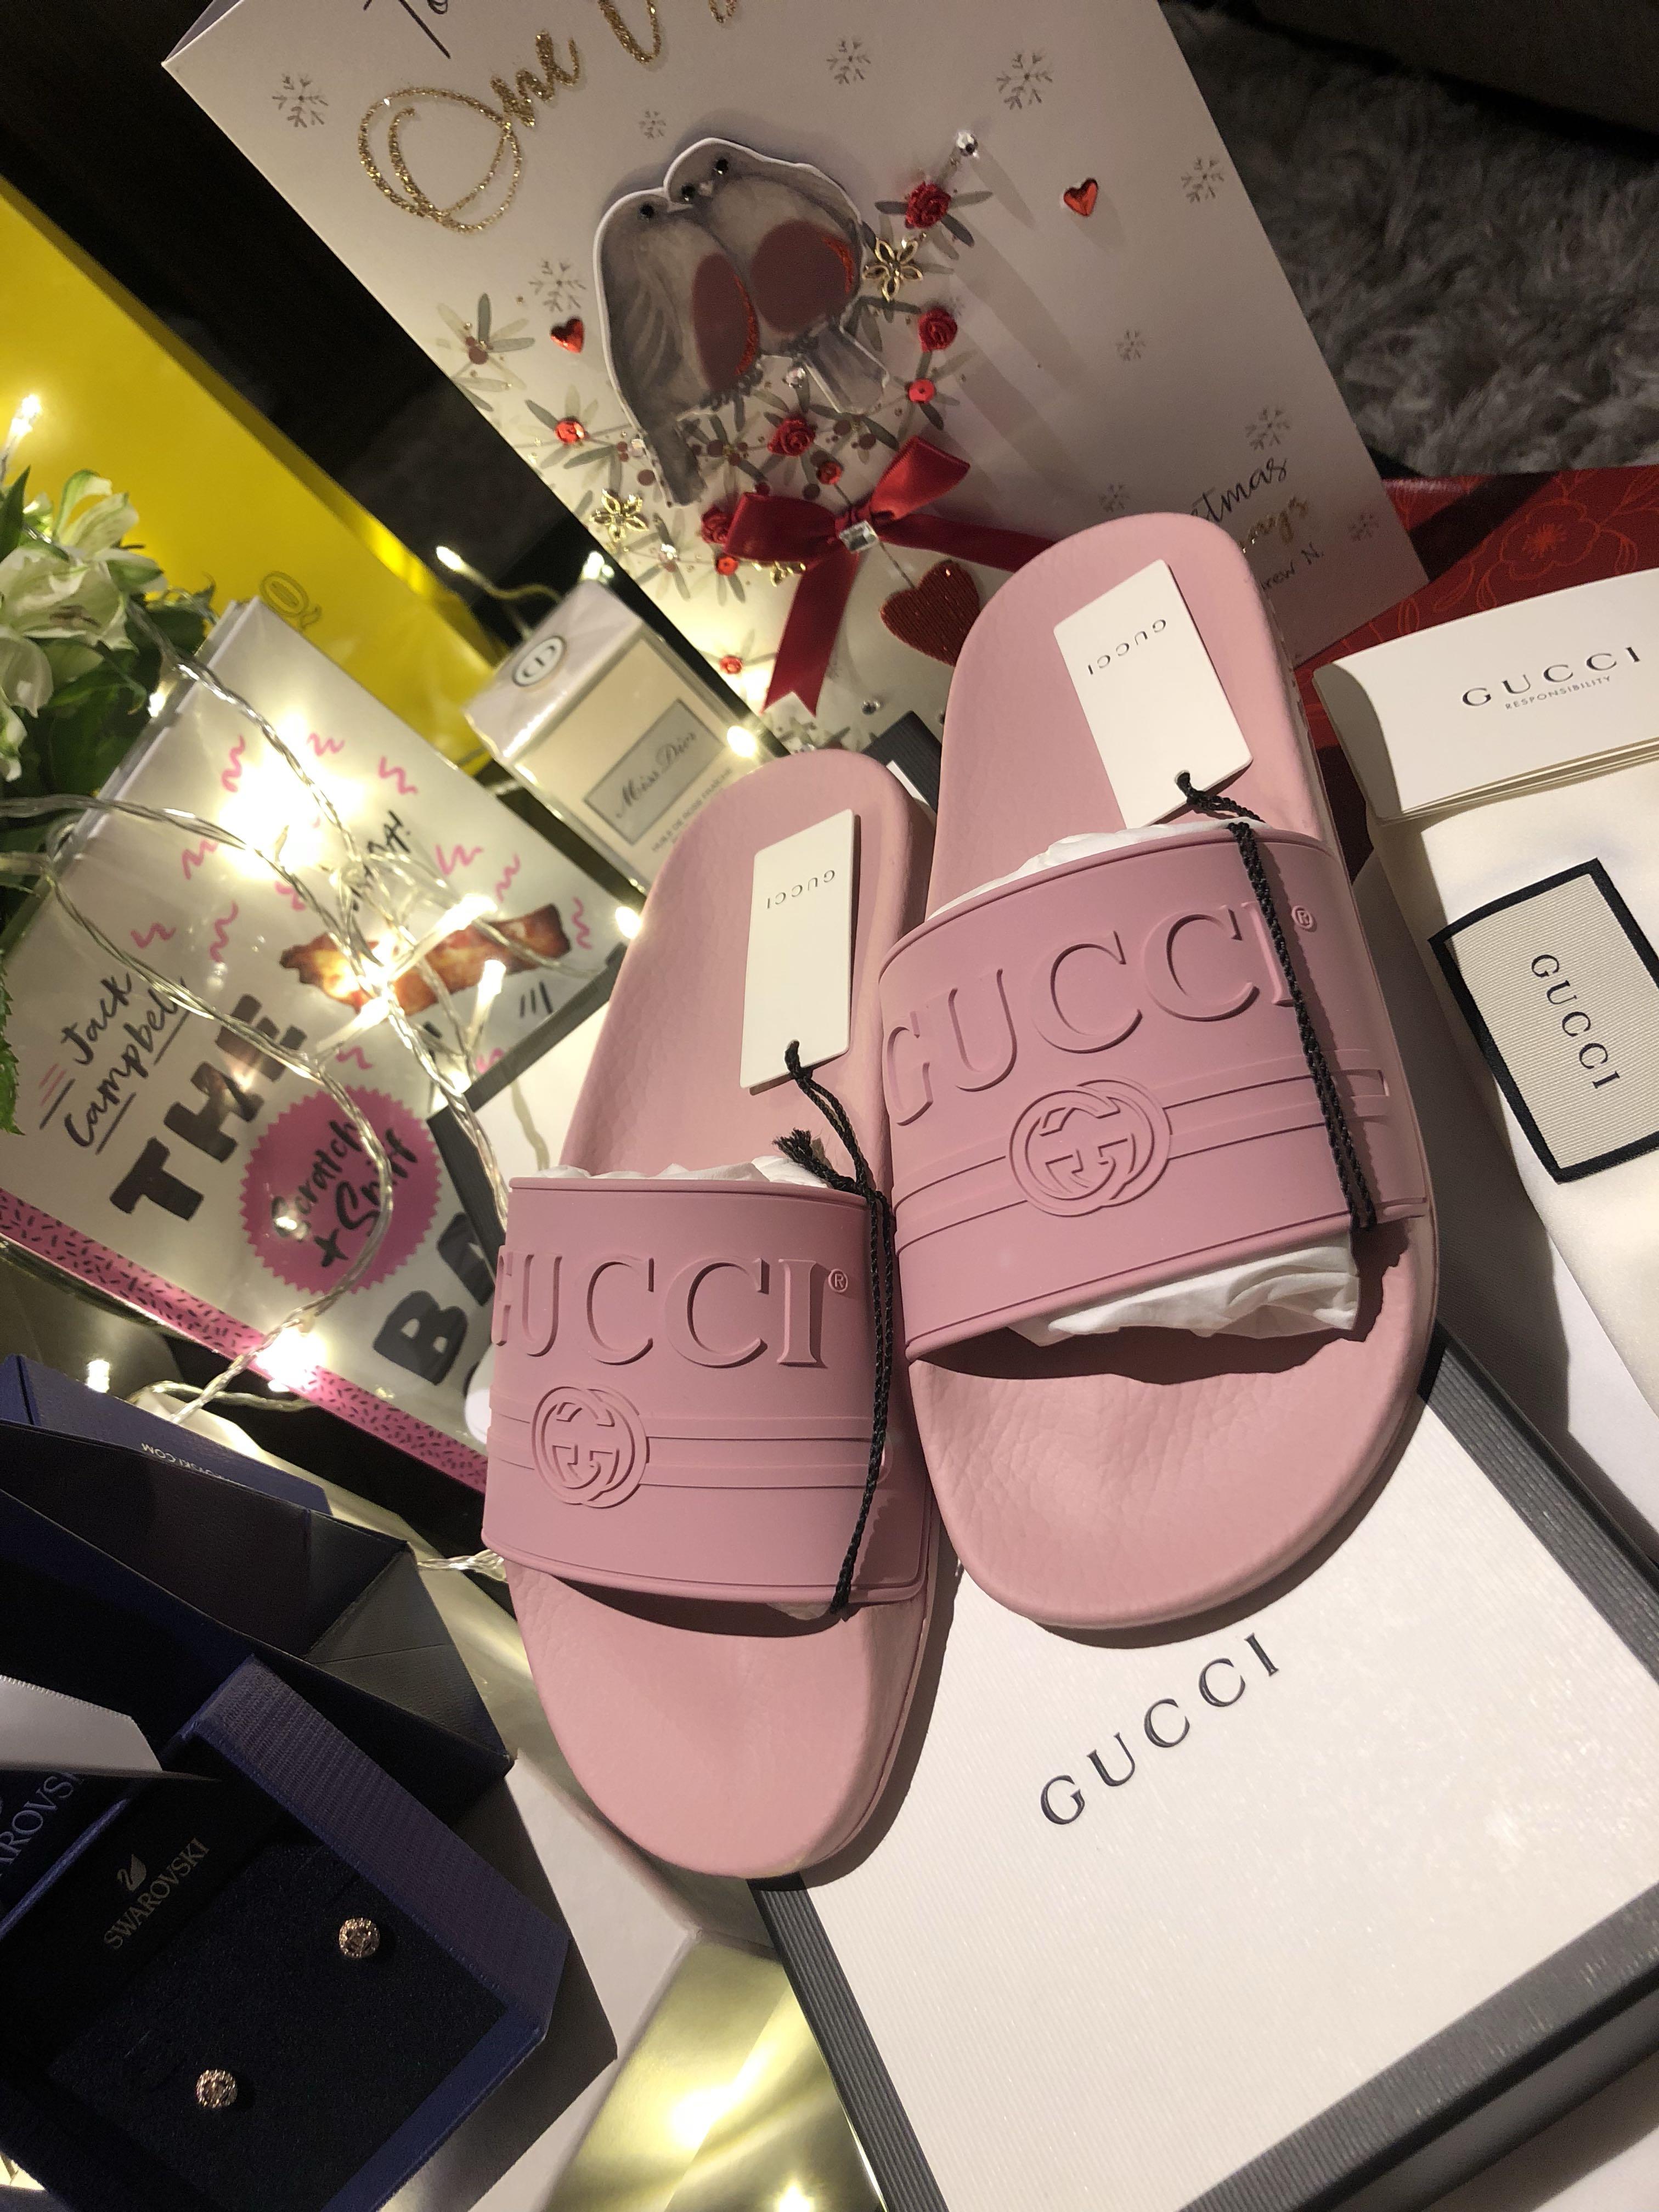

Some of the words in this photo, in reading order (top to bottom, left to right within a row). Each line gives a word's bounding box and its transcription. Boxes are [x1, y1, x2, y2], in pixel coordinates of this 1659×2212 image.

[1087, 618, 1166, 676] GUCCI
[1462, 646, 1640, 707] GUCCI
[1505, 675, 1611, 710] RESPONSIBILITY
[656, 732, 697, 775] Dior
[766, 870, 836, 909] GUCCI
[61, 972, 132, 1065] Jack
[64, 976, 188, 1147] Campbel
[1531, 952, 1621, 1089] GUCCI
[110, 994, 308, 1222] THE
[1040, 1632, 1279, 1825] GUCCI
[104, 1837, 210, 1949] SWAROVSKI
